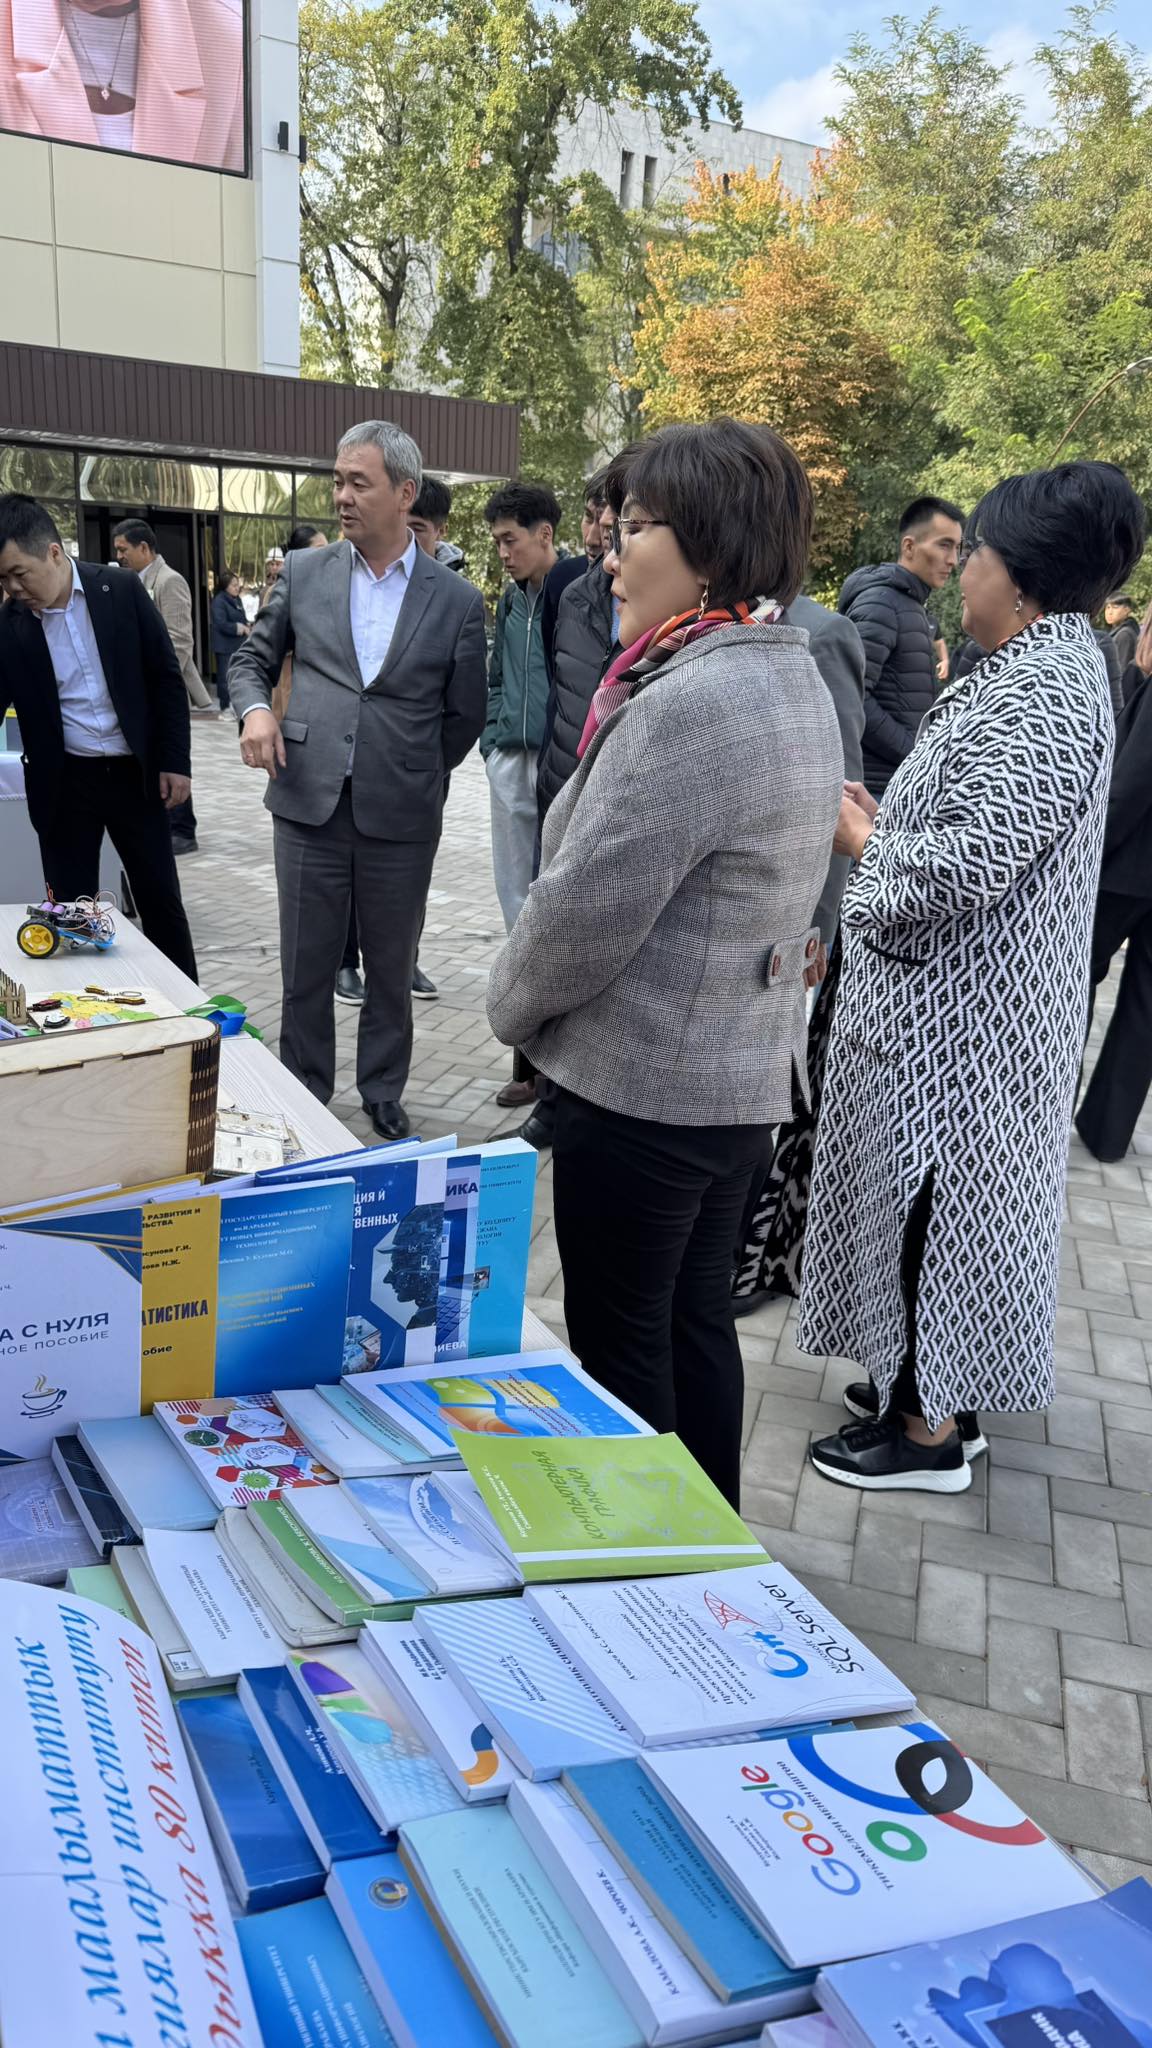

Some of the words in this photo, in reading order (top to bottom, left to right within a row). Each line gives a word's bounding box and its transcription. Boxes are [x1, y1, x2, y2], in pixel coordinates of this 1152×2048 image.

[353, 1191, 375, 1205] ЦИЯ
[446, 1182, 478, 1196] ИКА
[147, 1208, 193, 1221] РАЗВИТИЯ
[22, 1324, 38, 1338] С
[46, 1312, 110, 1335] НУЛЯ
[34, 1330, 110, 1350] ПОСОБИЕ
[143, 1344, 173, 1357] обие
[531, 1450, 604, 1539] КОМПЬЮТЕРНАЯ
[564, 1467, 616, 1516] ГРАФИКА
[760, 1582, 824, 1634] Server
[818, 1635, 864, 1673] SQL
[56, 1603, 145, 1853] институту
[118, 1636, 178, 1783] китеп
[14, 1635, 123, 2016] маалыматтык
[147, 1784, 196, 1854] 80
[804, 1791, 833, 1820] МЕНЕН
[740, 1764, 861, 1896] Google
